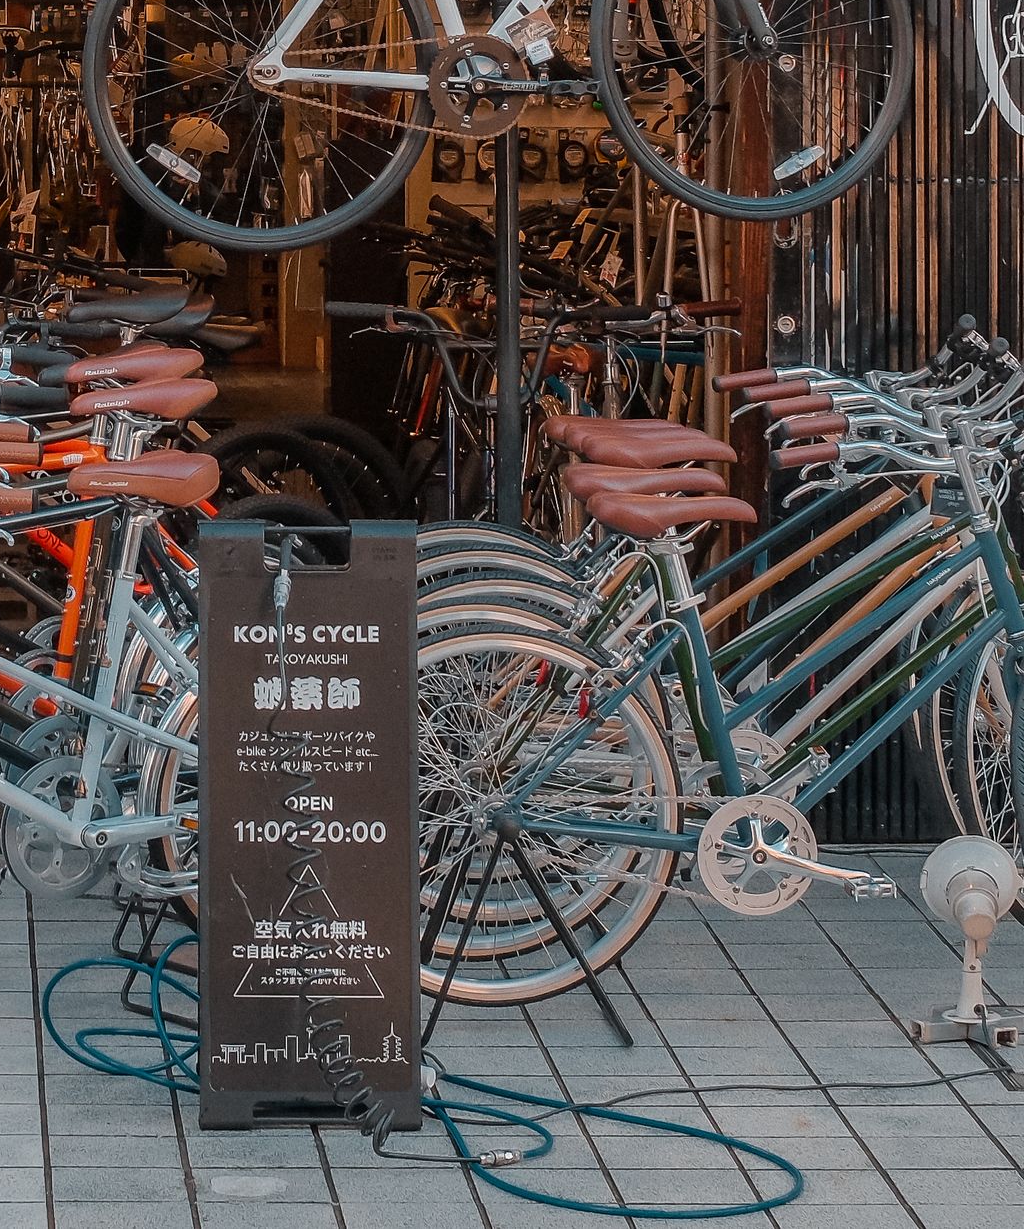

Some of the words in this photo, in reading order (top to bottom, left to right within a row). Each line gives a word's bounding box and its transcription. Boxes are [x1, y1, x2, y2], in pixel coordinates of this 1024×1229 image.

[84, 367, 118, 376] Raleigh
[94, 399, 130, 409] Raleigh
[312, 625, 380, 643] CYCLE
[265, 653, 348, 665] TAKOYAKUSHI
[268, 745, 353, 757] シンルスピード
[284, 796, 333, 811] OPEN
[255, 920, 368, 940] 空気入れ無料
